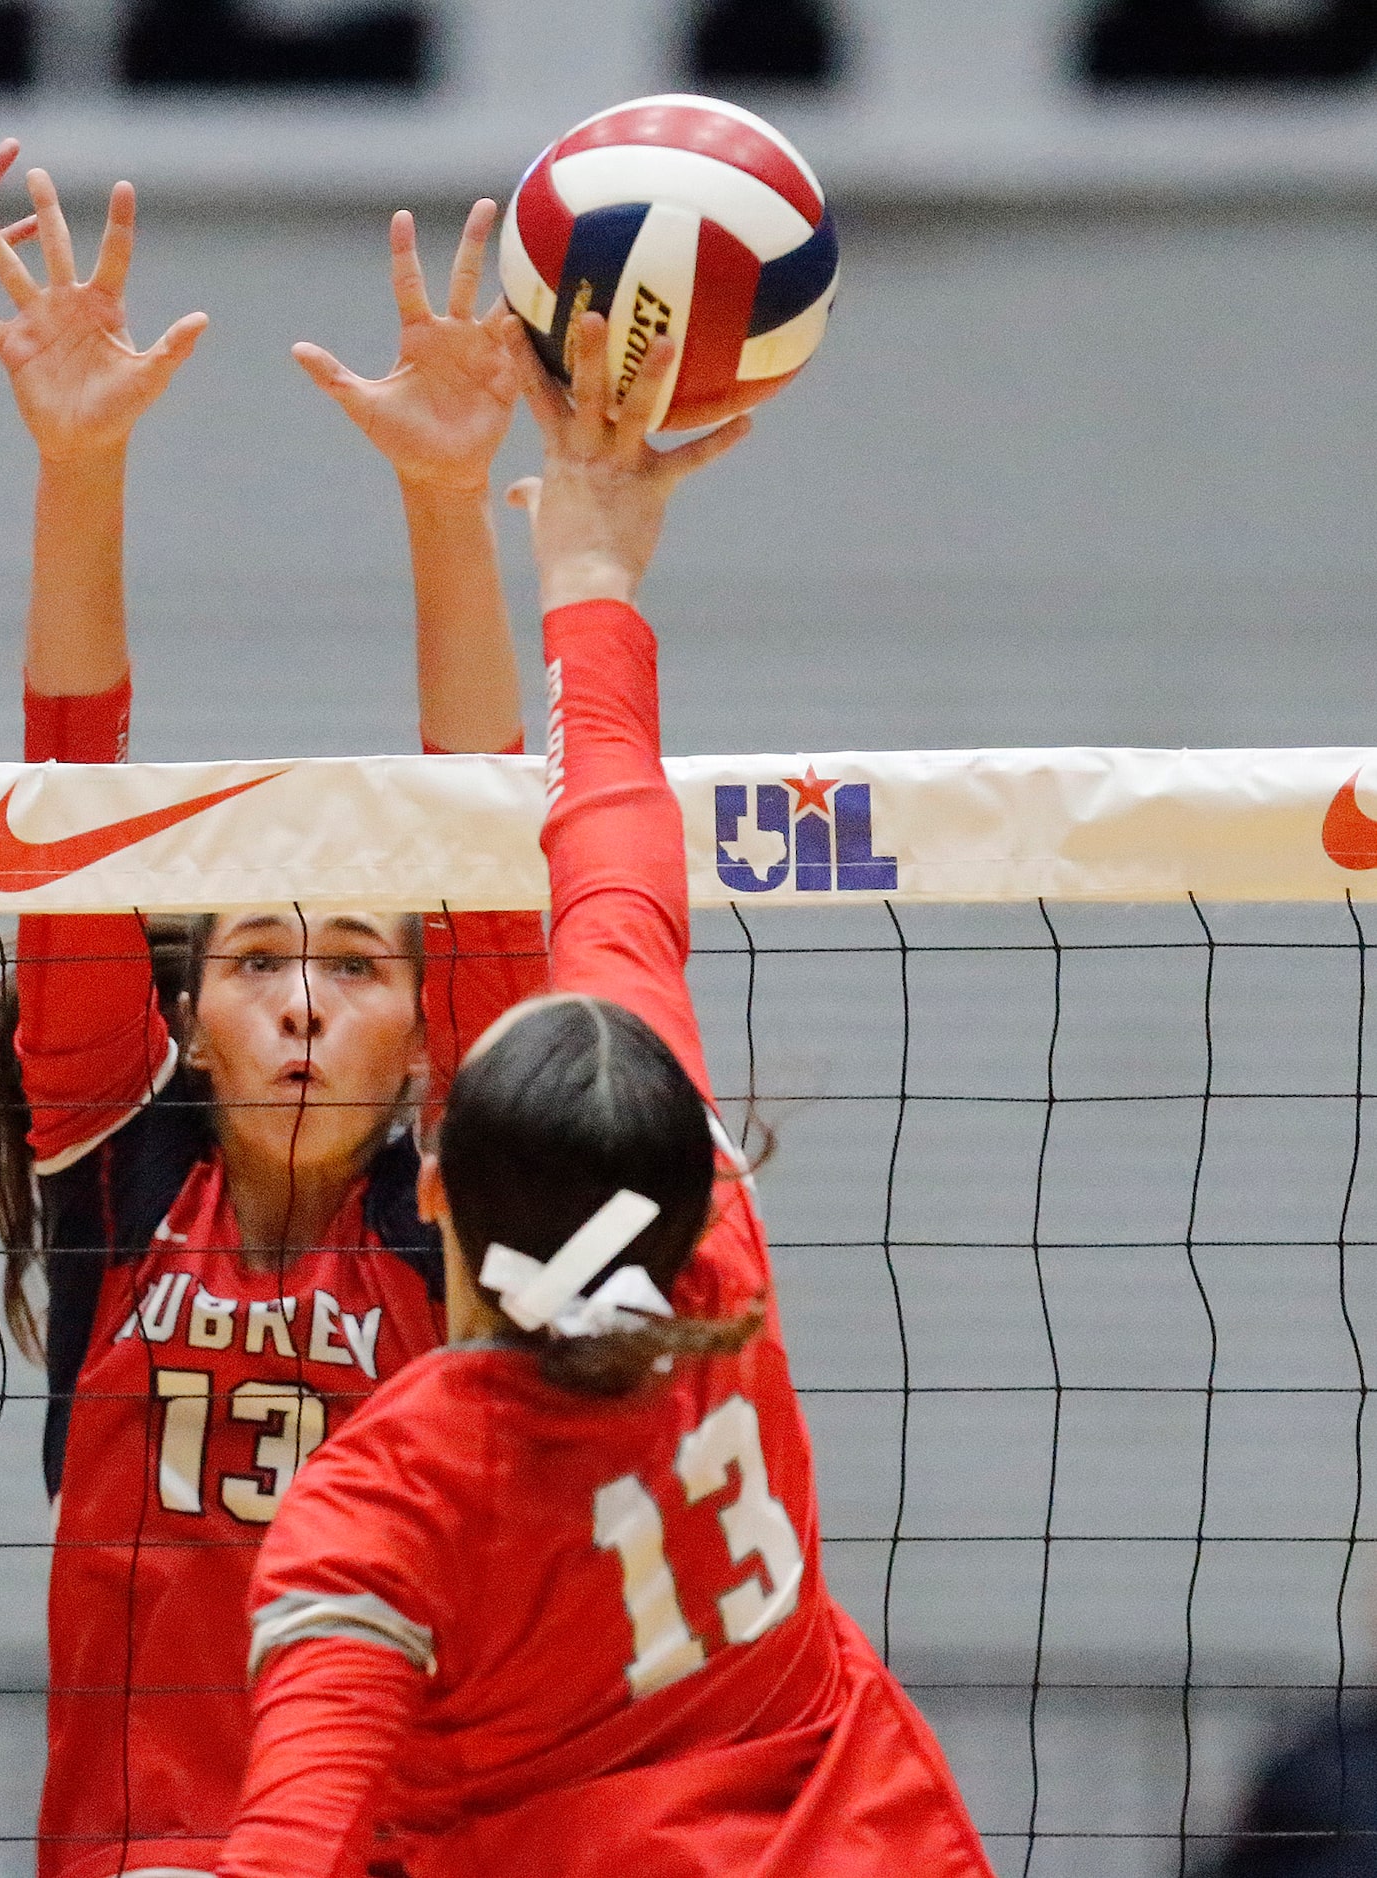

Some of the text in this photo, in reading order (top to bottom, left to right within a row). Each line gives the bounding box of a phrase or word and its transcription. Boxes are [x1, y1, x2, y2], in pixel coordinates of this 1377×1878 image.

[714, 778, 899, 893] UIL
[150, 1367, 328, 1526] 13
[591, 1392, 805, 1701] 13
